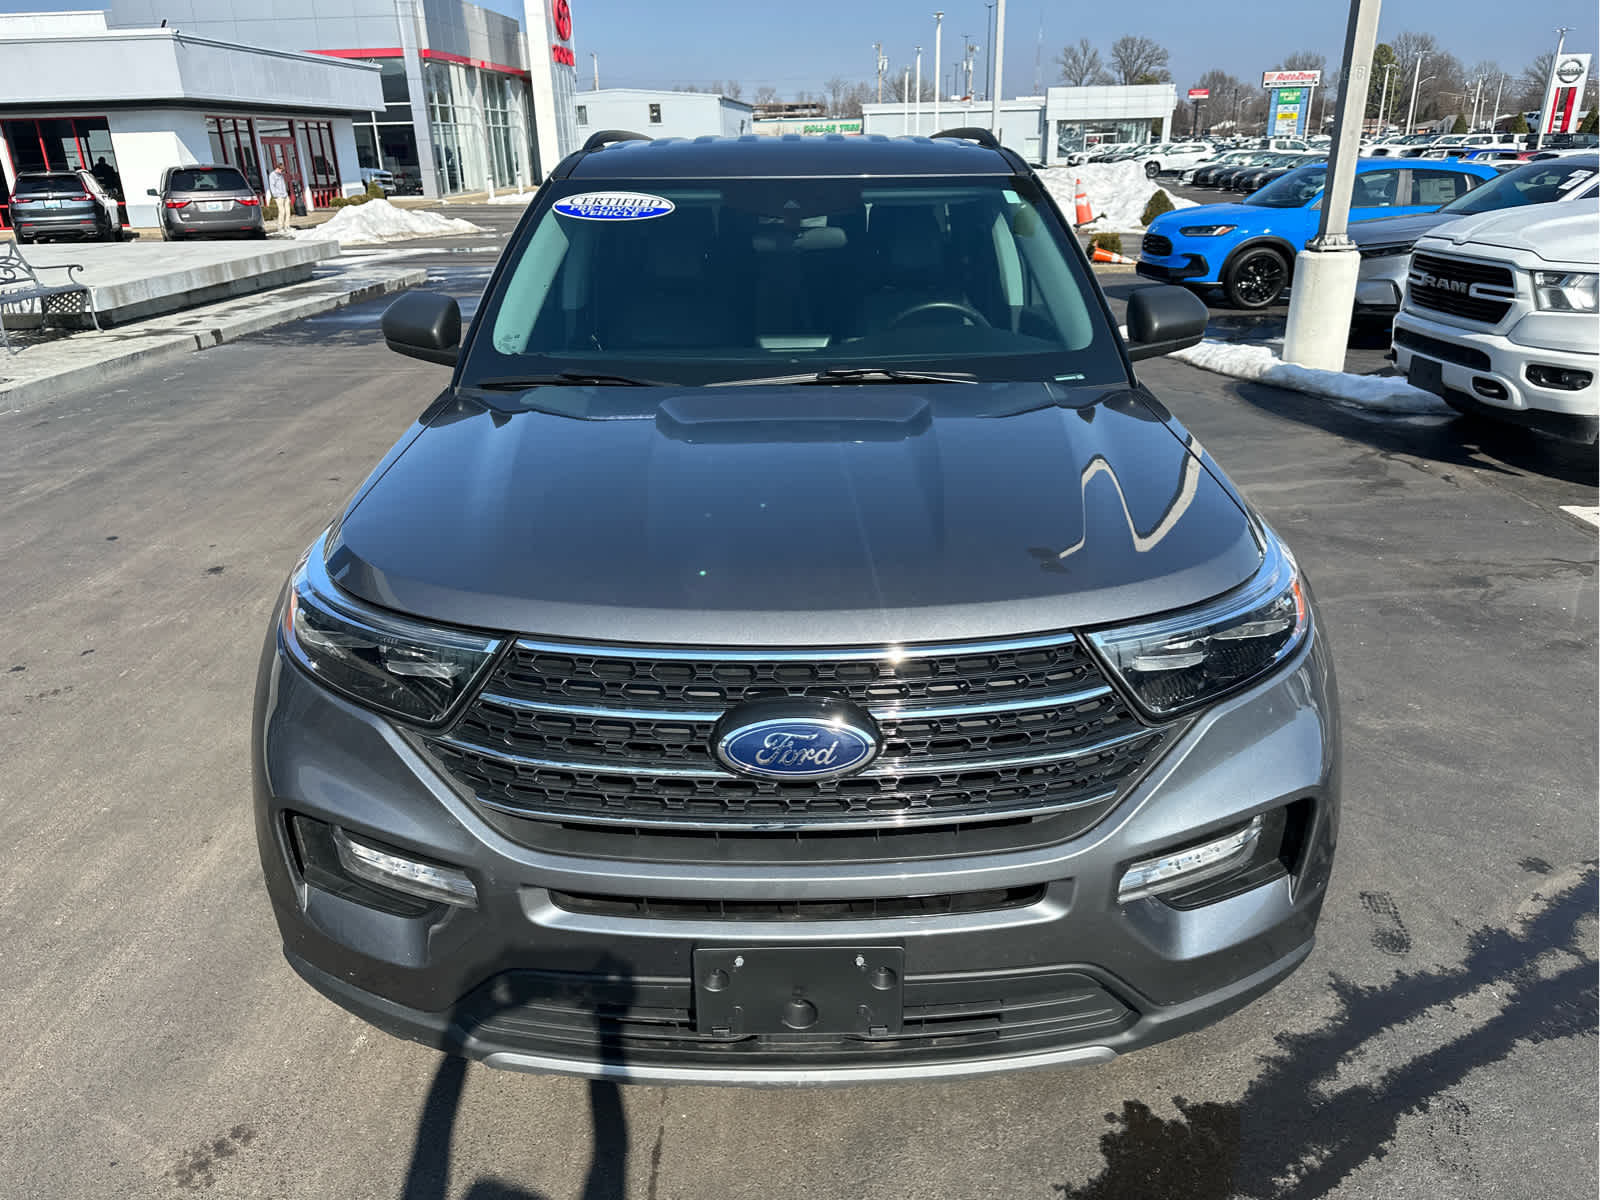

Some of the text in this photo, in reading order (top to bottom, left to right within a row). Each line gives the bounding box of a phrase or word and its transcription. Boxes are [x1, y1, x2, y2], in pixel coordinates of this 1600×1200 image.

[804, 123, 860, 133] DOLLAR TREE
[569, 197, 662, 207] CERTIFIED
[569, 205, 654, 213] PRE-OWNED
[1424, 274, 1468, 294] RAM
[755, 732, 839, 766] Ford
